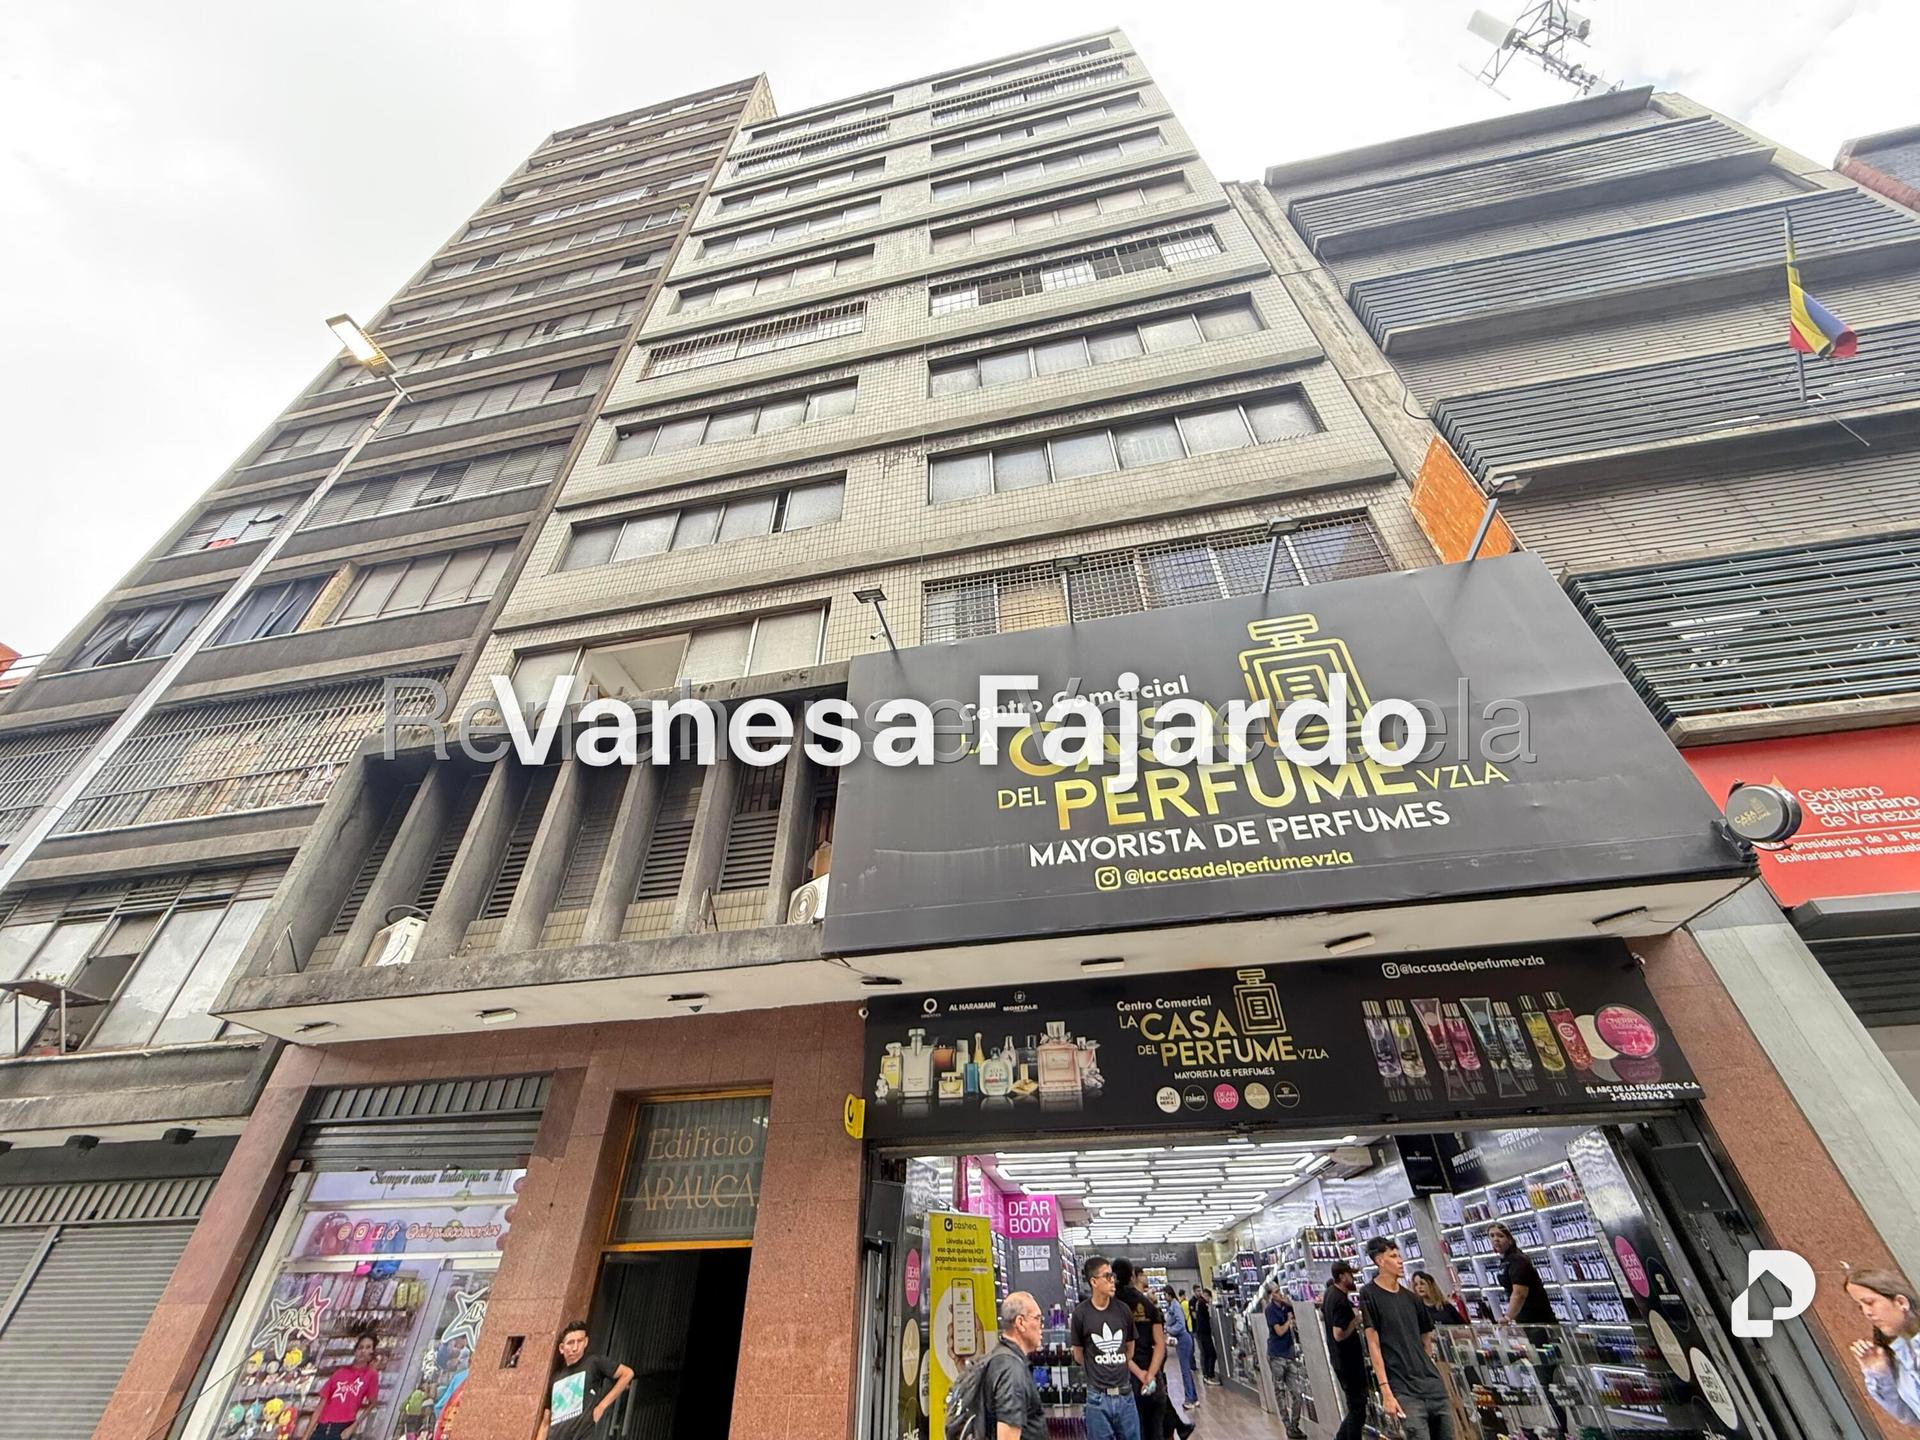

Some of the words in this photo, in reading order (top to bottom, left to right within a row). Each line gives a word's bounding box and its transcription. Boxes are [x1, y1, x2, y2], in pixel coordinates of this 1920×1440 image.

[997, 786, 1047, 810] DEL
[1054, 741, 1418, 831] PERFUME
[1416, 762, 1510, 791] VZLA
[1797, 785, 1884, 803] Gobierno
[1806, 795, 1919, 816] Bolivariano
[1820, 813, 1847, 828] de
[1029, 826, 1206, 868] MAYORISTA
[1214, 820, 1260, 848] DE
[1267, 800, 1451, 843] PERFUMES
[1865, 833, 1882, 843] de
[1774, 849, 1844, 864] Bolivariana
[1843, 847, 1862, 858] de
[1125, 849, 1354, 886] @lacasadelperfumevzla
[1400, 955, 1545, 974] @lacasadelperfumevzla
[959, 1002, 996, 1010] HARAMAIN
[1116, 1000, 1153, 1012] Centro
[1156, 995, 1212, 1009] Comercial
[1119, 1015, 1138, 1029] LA
[1140, 1009, 1237, 1041] CASA
[1137, 1045, 1157, 1055] DEL
[1160, 1035, 1298, 1067] PERFUME
[1297, 1048, 1329, 1059] VZLA
[1174, 1069, 1218, 1080] MAYORISTA
[1220, 1068, 1232, 1077] DE
[1233, 1066, 1275, 1076] PERFUMES
[648, 1126, 754, 1160] Edificio
[411, 1173, 436, 1185] cosas
[629, 1172, 755, 1211] ARAUCA
[1009, 1200, 1050, 1217] DEAR
[1010, 1217, 1050, 1234] BODY
[1095, 1350, 1126, 1364] adidas
